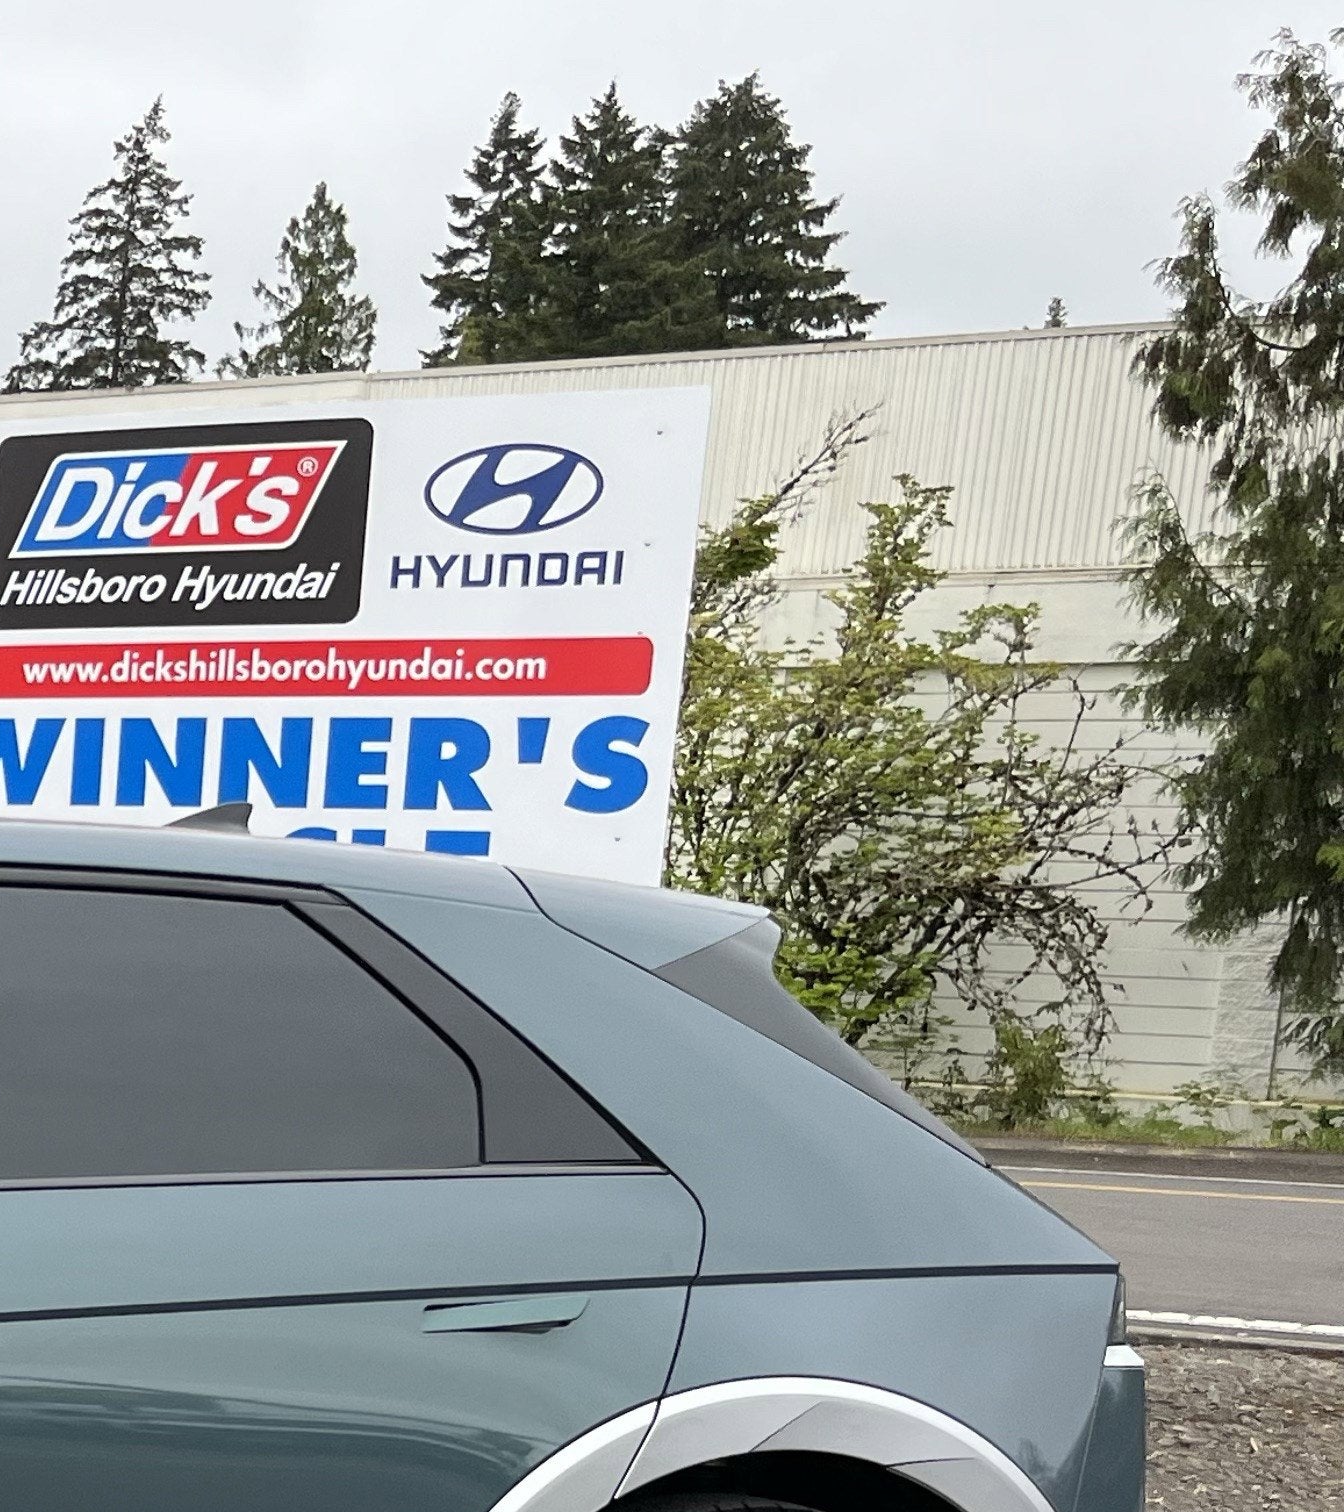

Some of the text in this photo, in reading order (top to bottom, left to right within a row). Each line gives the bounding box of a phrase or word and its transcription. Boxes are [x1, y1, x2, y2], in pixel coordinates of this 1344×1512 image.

[34, 456, 299, 542] Dick's
[0, 562, 341, 611] Hillsboro Hyundai
[391, 550, 624, 590] HYUNDAI
[22, 648, 547, 689] www.dickshillsborohyundai.com
